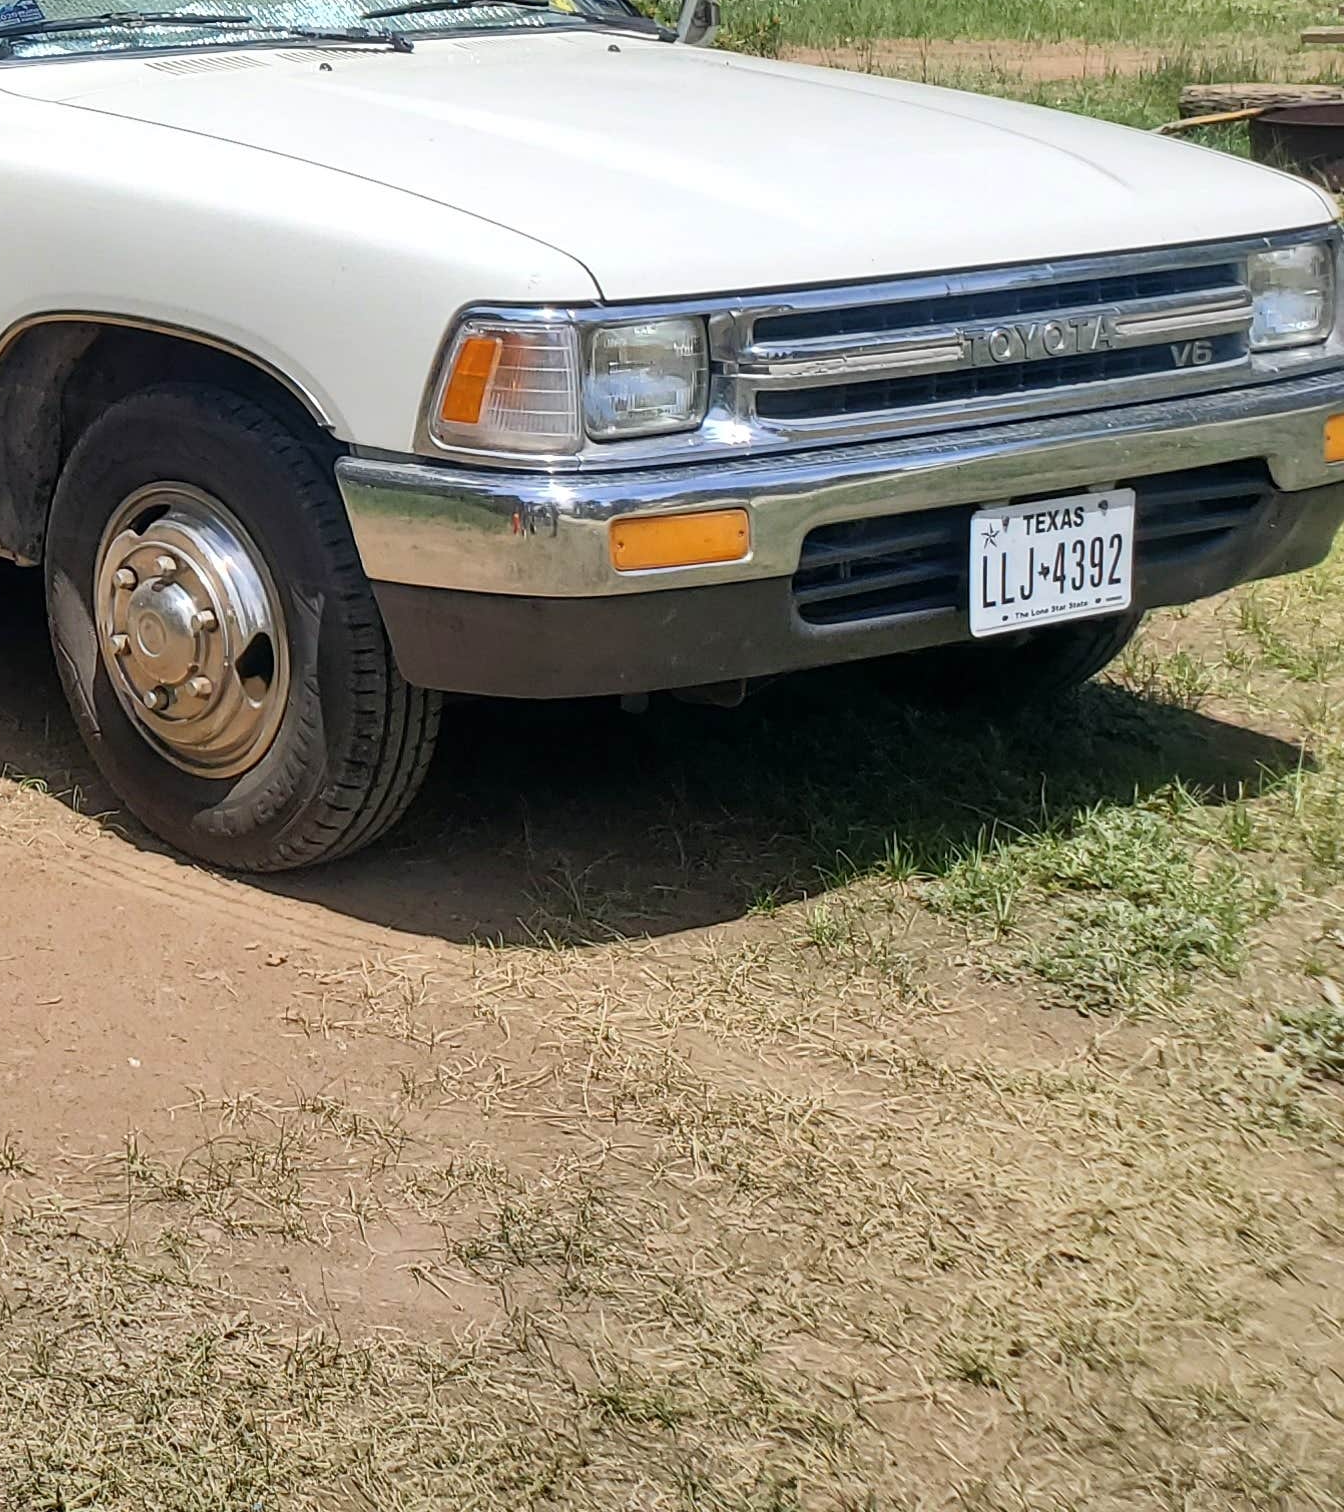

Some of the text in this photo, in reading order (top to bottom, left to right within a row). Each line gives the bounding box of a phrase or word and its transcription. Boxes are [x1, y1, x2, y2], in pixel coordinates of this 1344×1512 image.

[963, 314, 1113, 367] TOYOTA
[1170, 340, 1213, 367] V6
[1023, 506, 1085, 536] TEXAS
